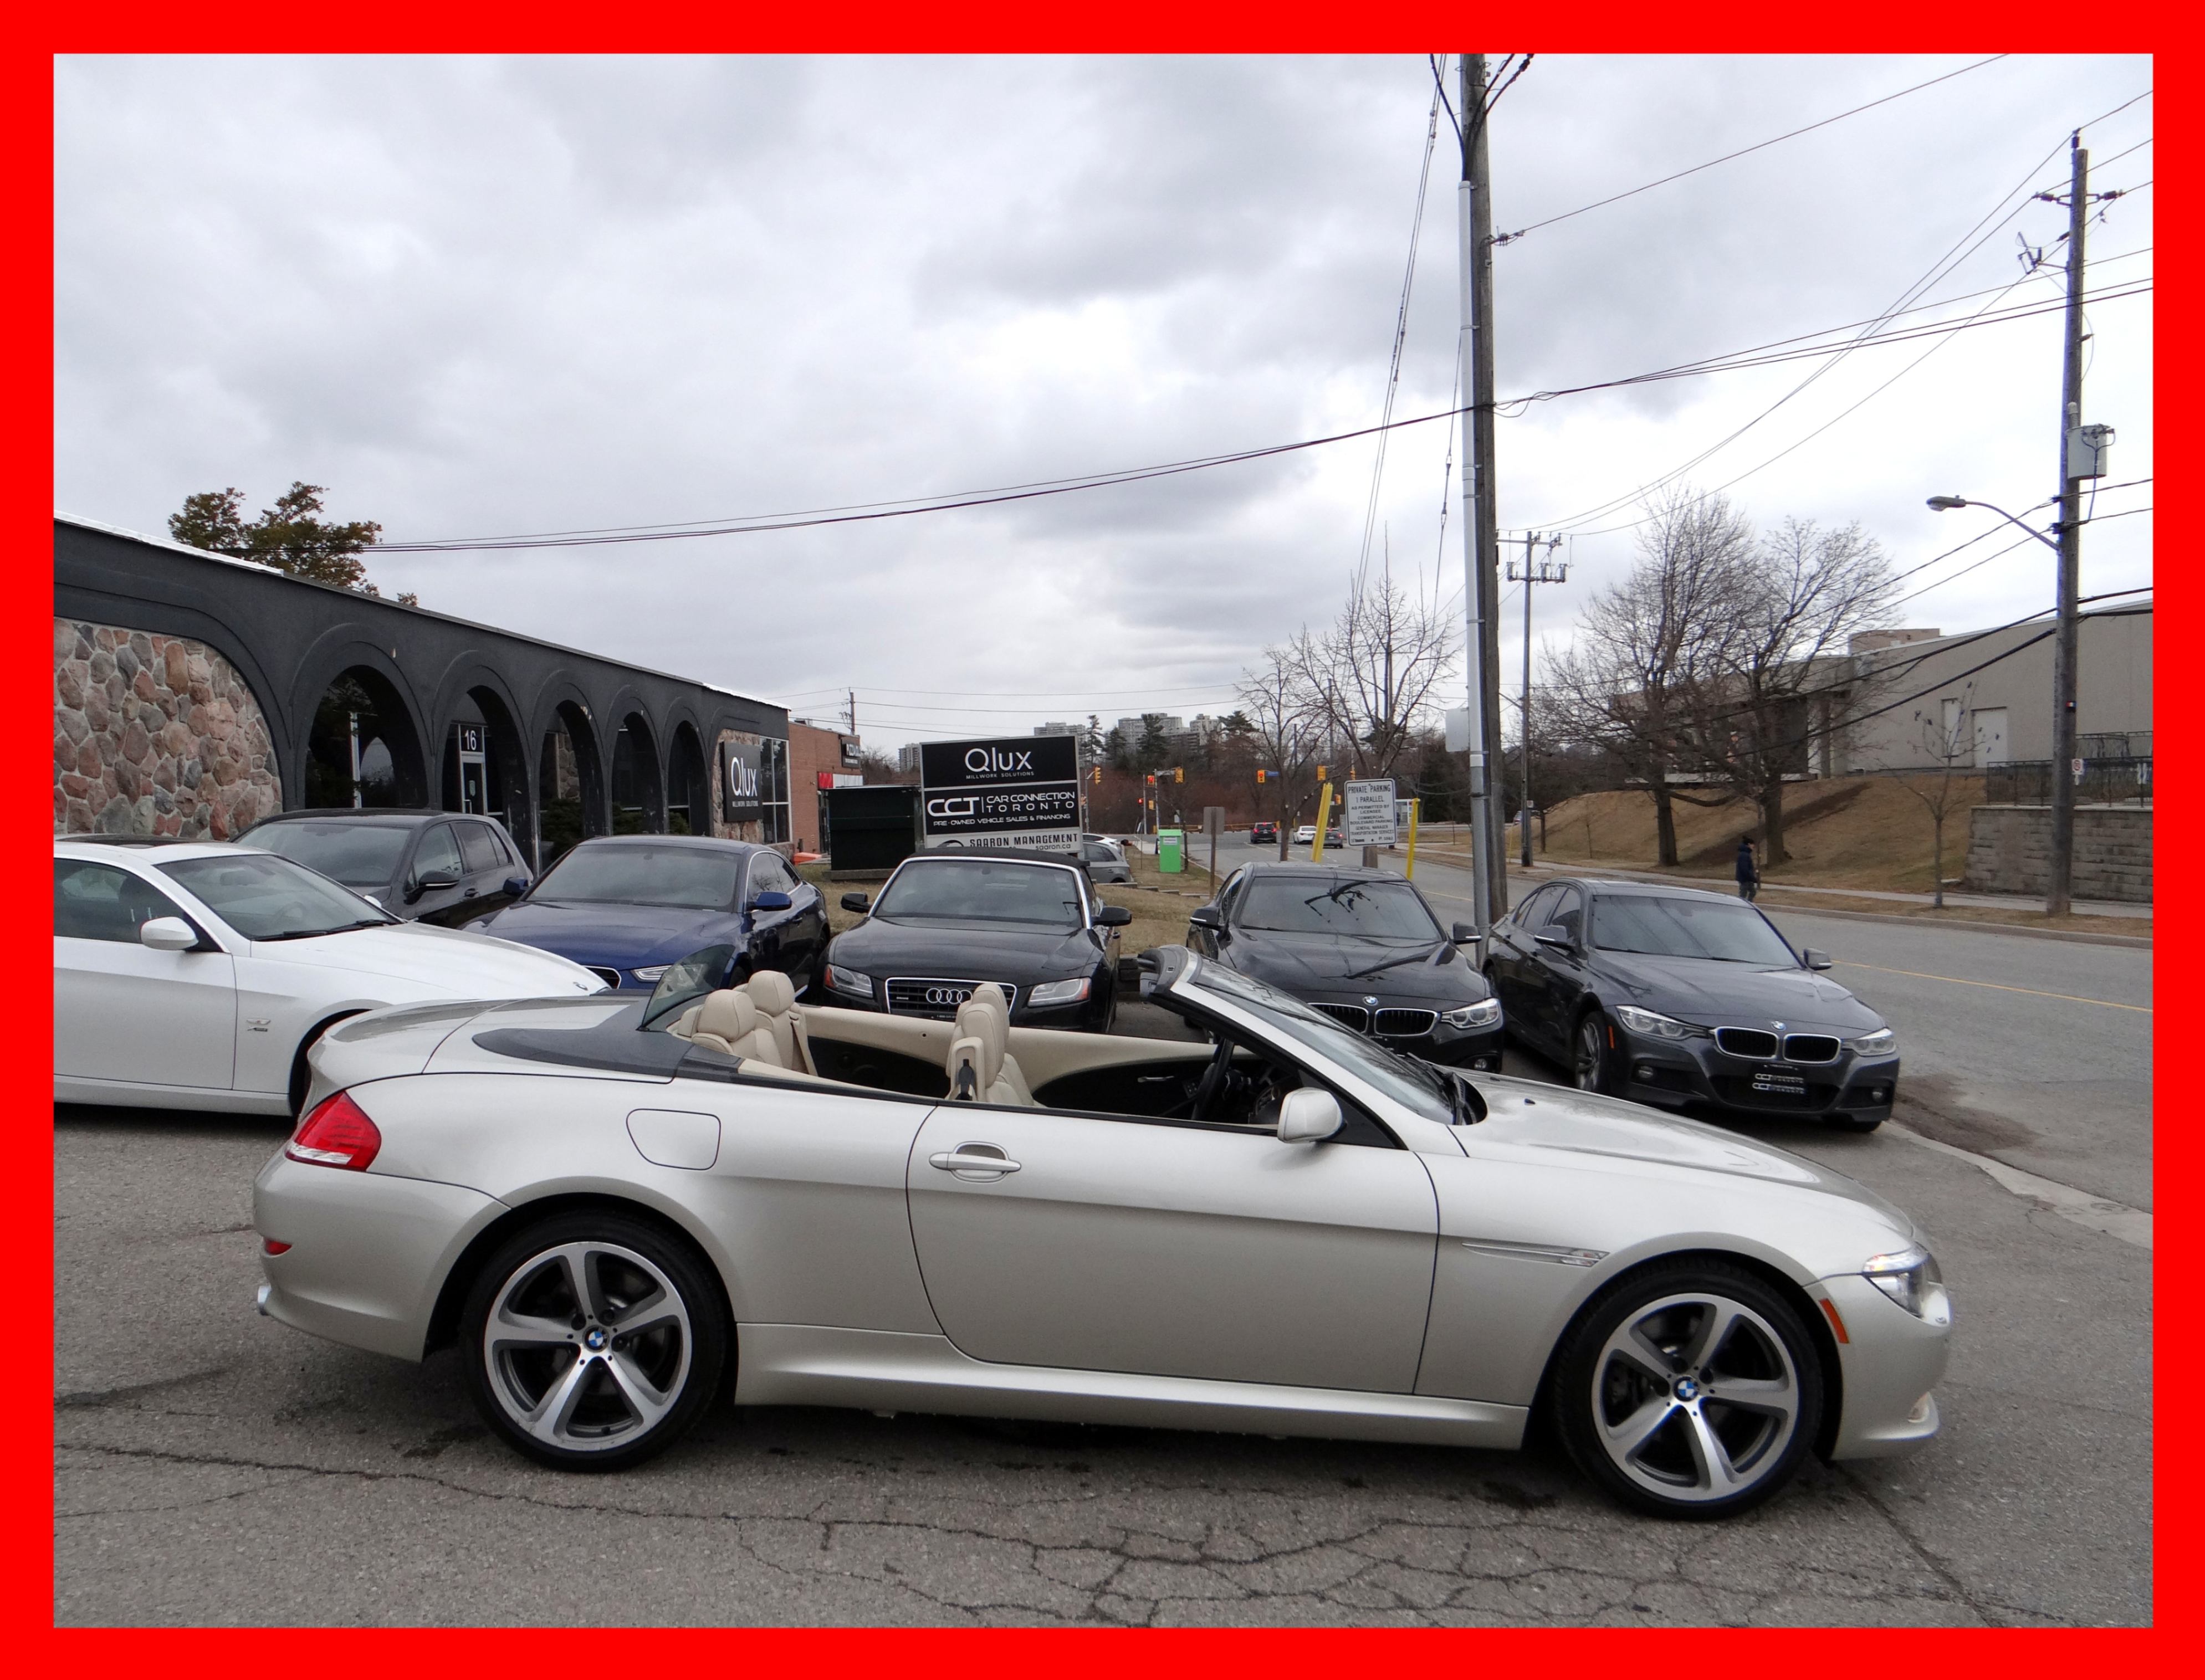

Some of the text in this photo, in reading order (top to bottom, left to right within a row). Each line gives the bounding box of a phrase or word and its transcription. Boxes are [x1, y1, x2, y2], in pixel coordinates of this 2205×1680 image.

[465, 730, 477, 750] 16
[965, 747, 1032, 772] Qlux
[731, 757, 758, 797] Qlux
[927, 797, 980, 817] CCT
[986, 791, 1075, 803] CAR CONNECTION
[986, 801, 1075, 813] TORONTO
[970, 833, 1078, 847] SAARON MANAGEMENT
